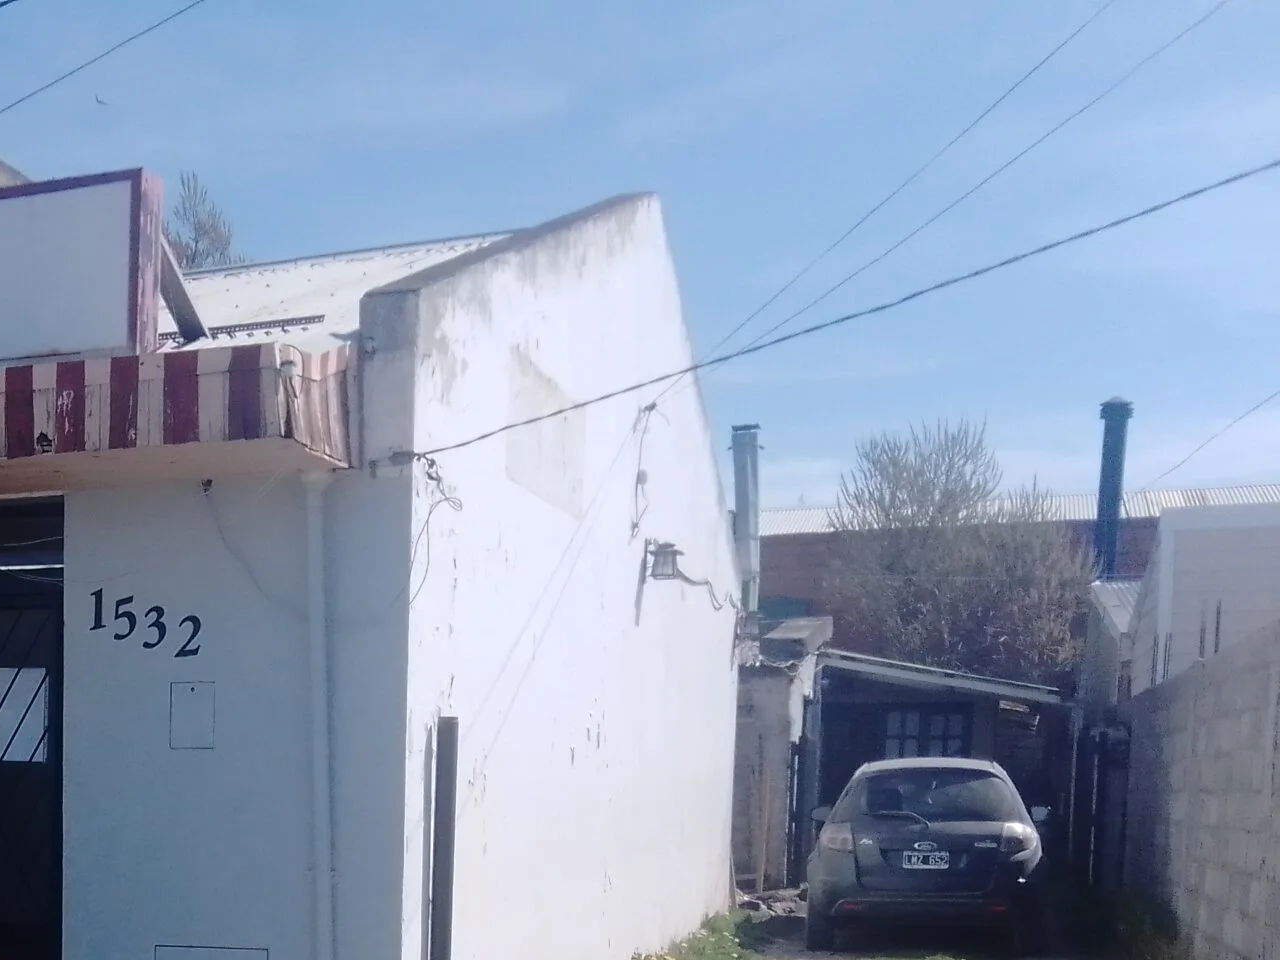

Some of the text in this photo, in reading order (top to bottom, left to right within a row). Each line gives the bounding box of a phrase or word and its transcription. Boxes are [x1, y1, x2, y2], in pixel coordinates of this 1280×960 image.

[89, 587, 202, 658] 1532
[905, 855, 948, 866] LMZ 652
